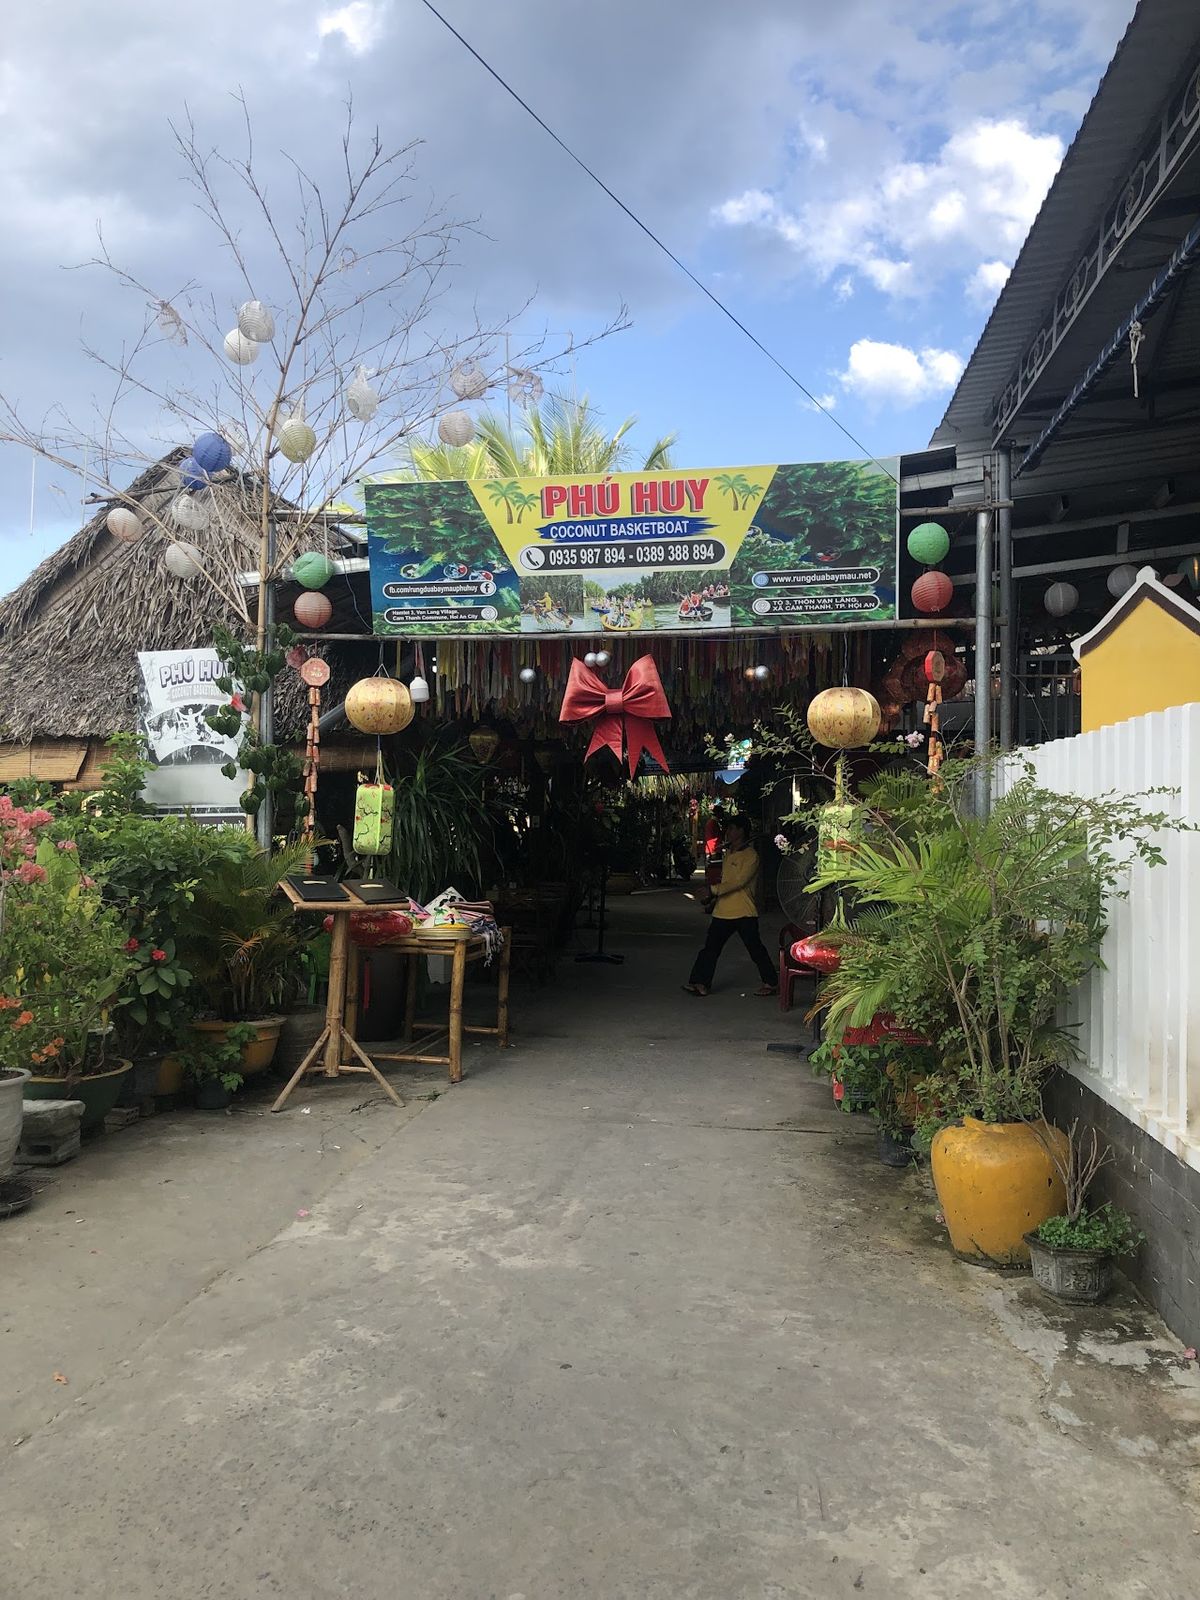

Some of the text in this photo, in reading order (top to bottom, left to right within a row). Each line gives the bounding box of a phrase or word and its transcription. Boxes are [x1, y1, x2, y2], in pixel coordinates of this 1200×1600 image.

[541, 476, 710, 519] PHÚ HUY
[550, 521, 689, 539] COCONUT BASKETBOAT
[550, 549, 577, 566] 0935
[580, 548, 600, 565] 987
[604, 547, 626, 564] 894
[636, 546, 665, 563] 0389
[668, 545, 689, 561] 388
[692, 544, 715, 560] 894
[772, 572, 872, 583] www.rungduabaymau.net
[389, 584, 478, 595] fb.com/rungduabaymauphuhuy
[160, 655, 194, 688] PHÚ
